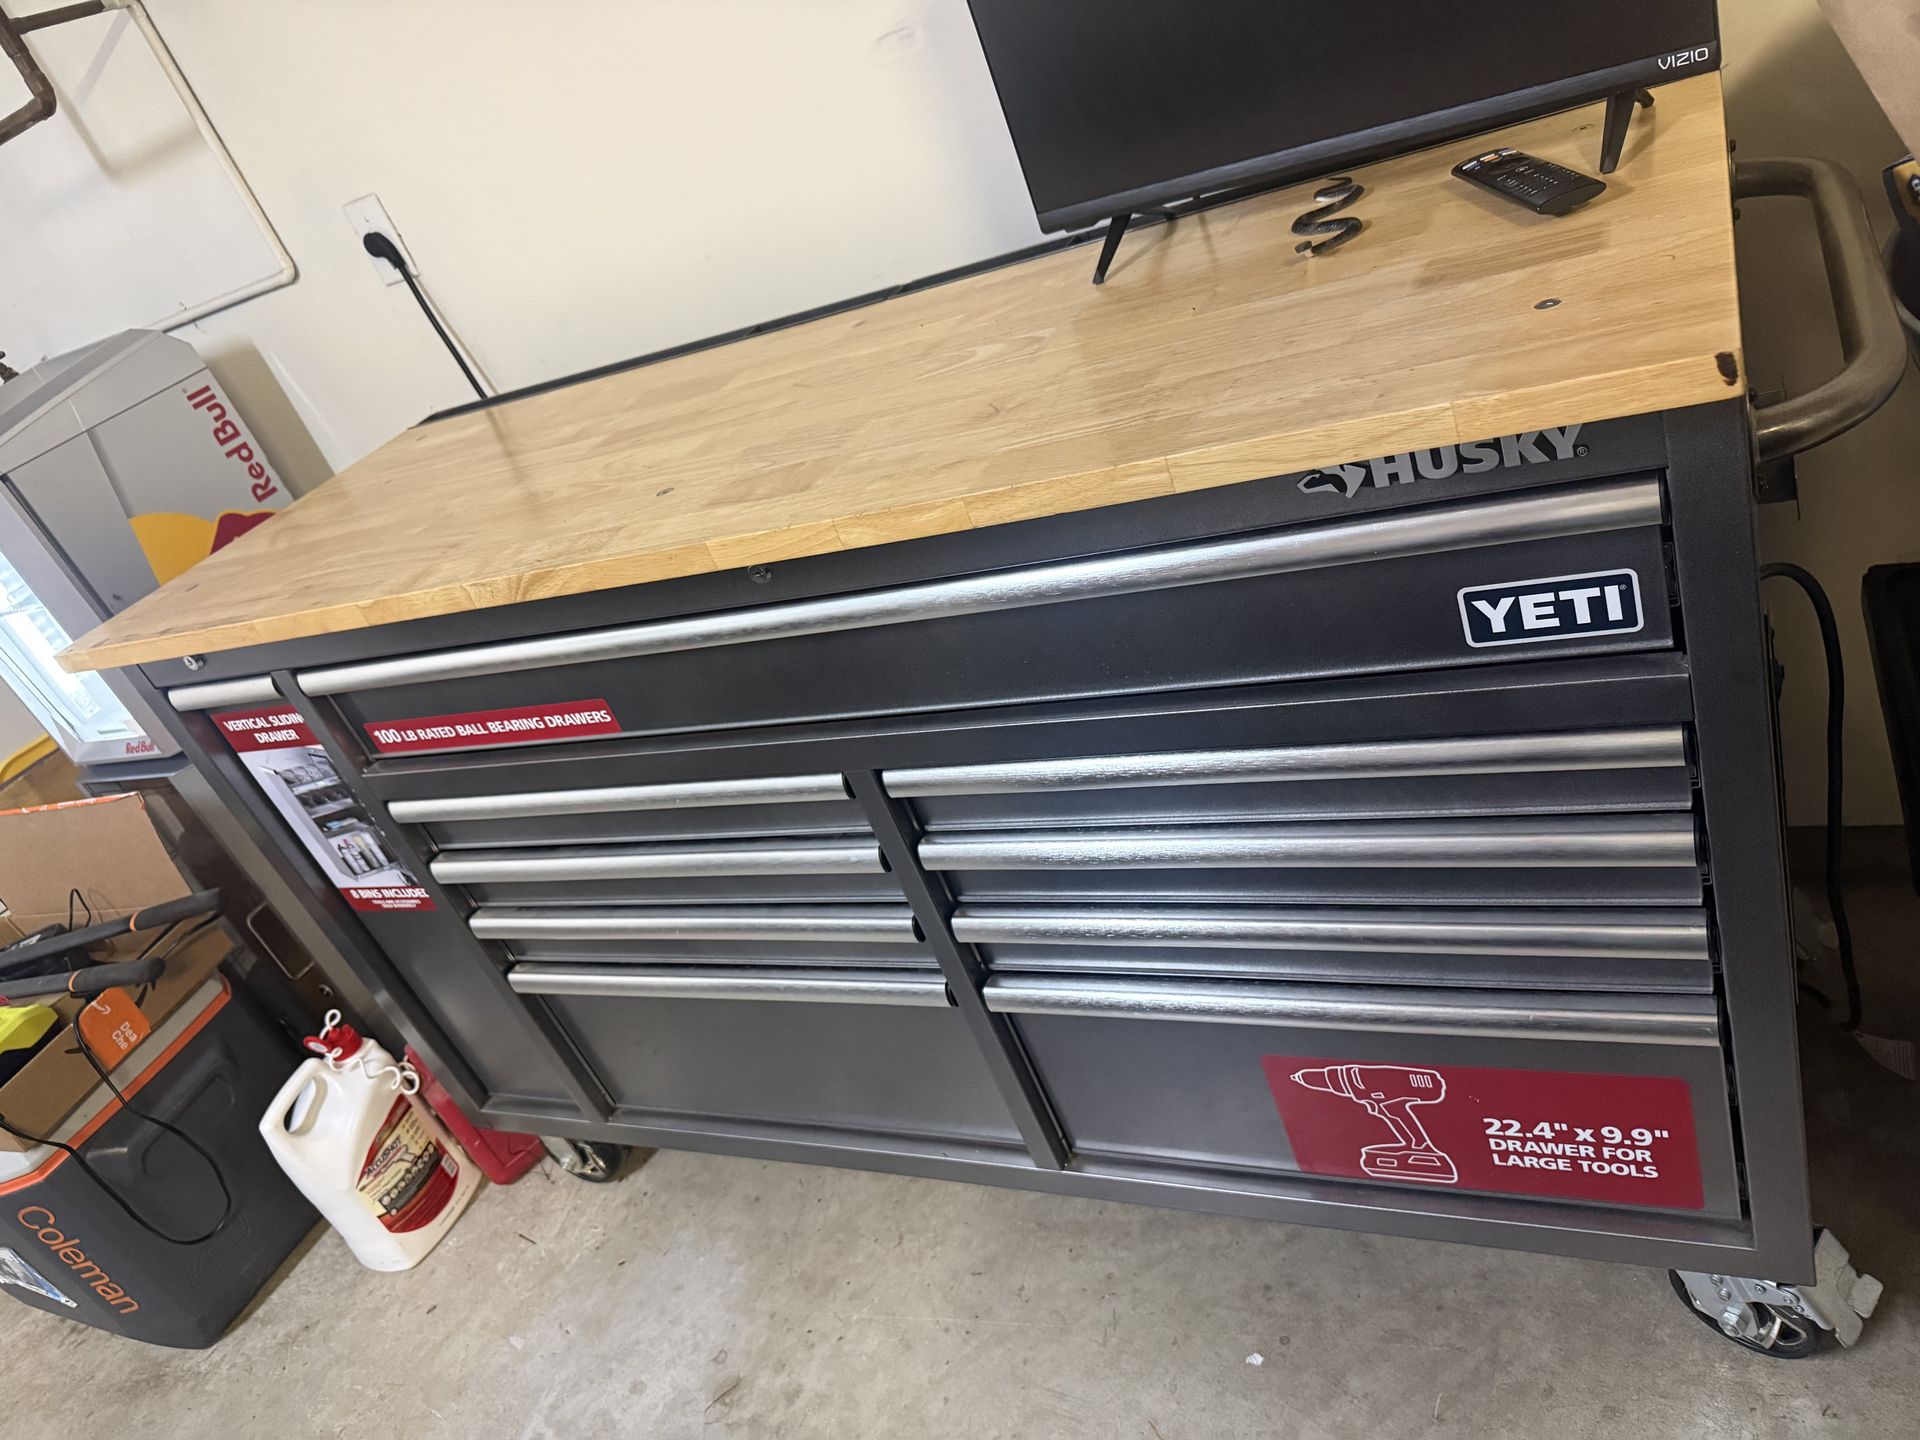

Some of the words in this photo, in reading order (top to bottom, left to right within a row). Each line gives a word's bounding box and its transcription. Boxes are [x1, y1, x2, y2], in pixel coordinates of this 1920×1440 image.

[1657, 47, 1709, 70] VIZIO
[1369, 423, 1583, 488] HUSKY
[1470, 584, 1624, 634] YETI
[223, 717, 272, 732] VERTICAL
[268, 712, 305, 727] SLIDIN
[373, 728, 402, 744] 100
[401, 729, 418, 742] LB
[417, 726, 456, 740] RATED
[457, 723, 489, 737] BALL
[486, 717, 546, 734] BEARING
[543, 709, 612, 728] DRAWERS
[253, 729, 301, 744] DRAWER
[349, 888, 360, 899] 8
[359, 888, 383, 899] BINS
[112, 1030, 129, 1050] Che
[120, 1021, 138, 1042] Dea
[1482, 1117, 1568, 1140] 22.4"
[1573, 1127, 1597, 1143] x
[1600, 1125, 1670, 1147] 9.9"
[1488, 1138, 1597, 1159] DRAWER
[1601, 1146, 1653, 1163] FOR
[1492, 1153, 1573, 1172] LARGE
[1577, 1159, 1659, 1179] TOOLS
[17, 1205, 141, 1314] Coleman
